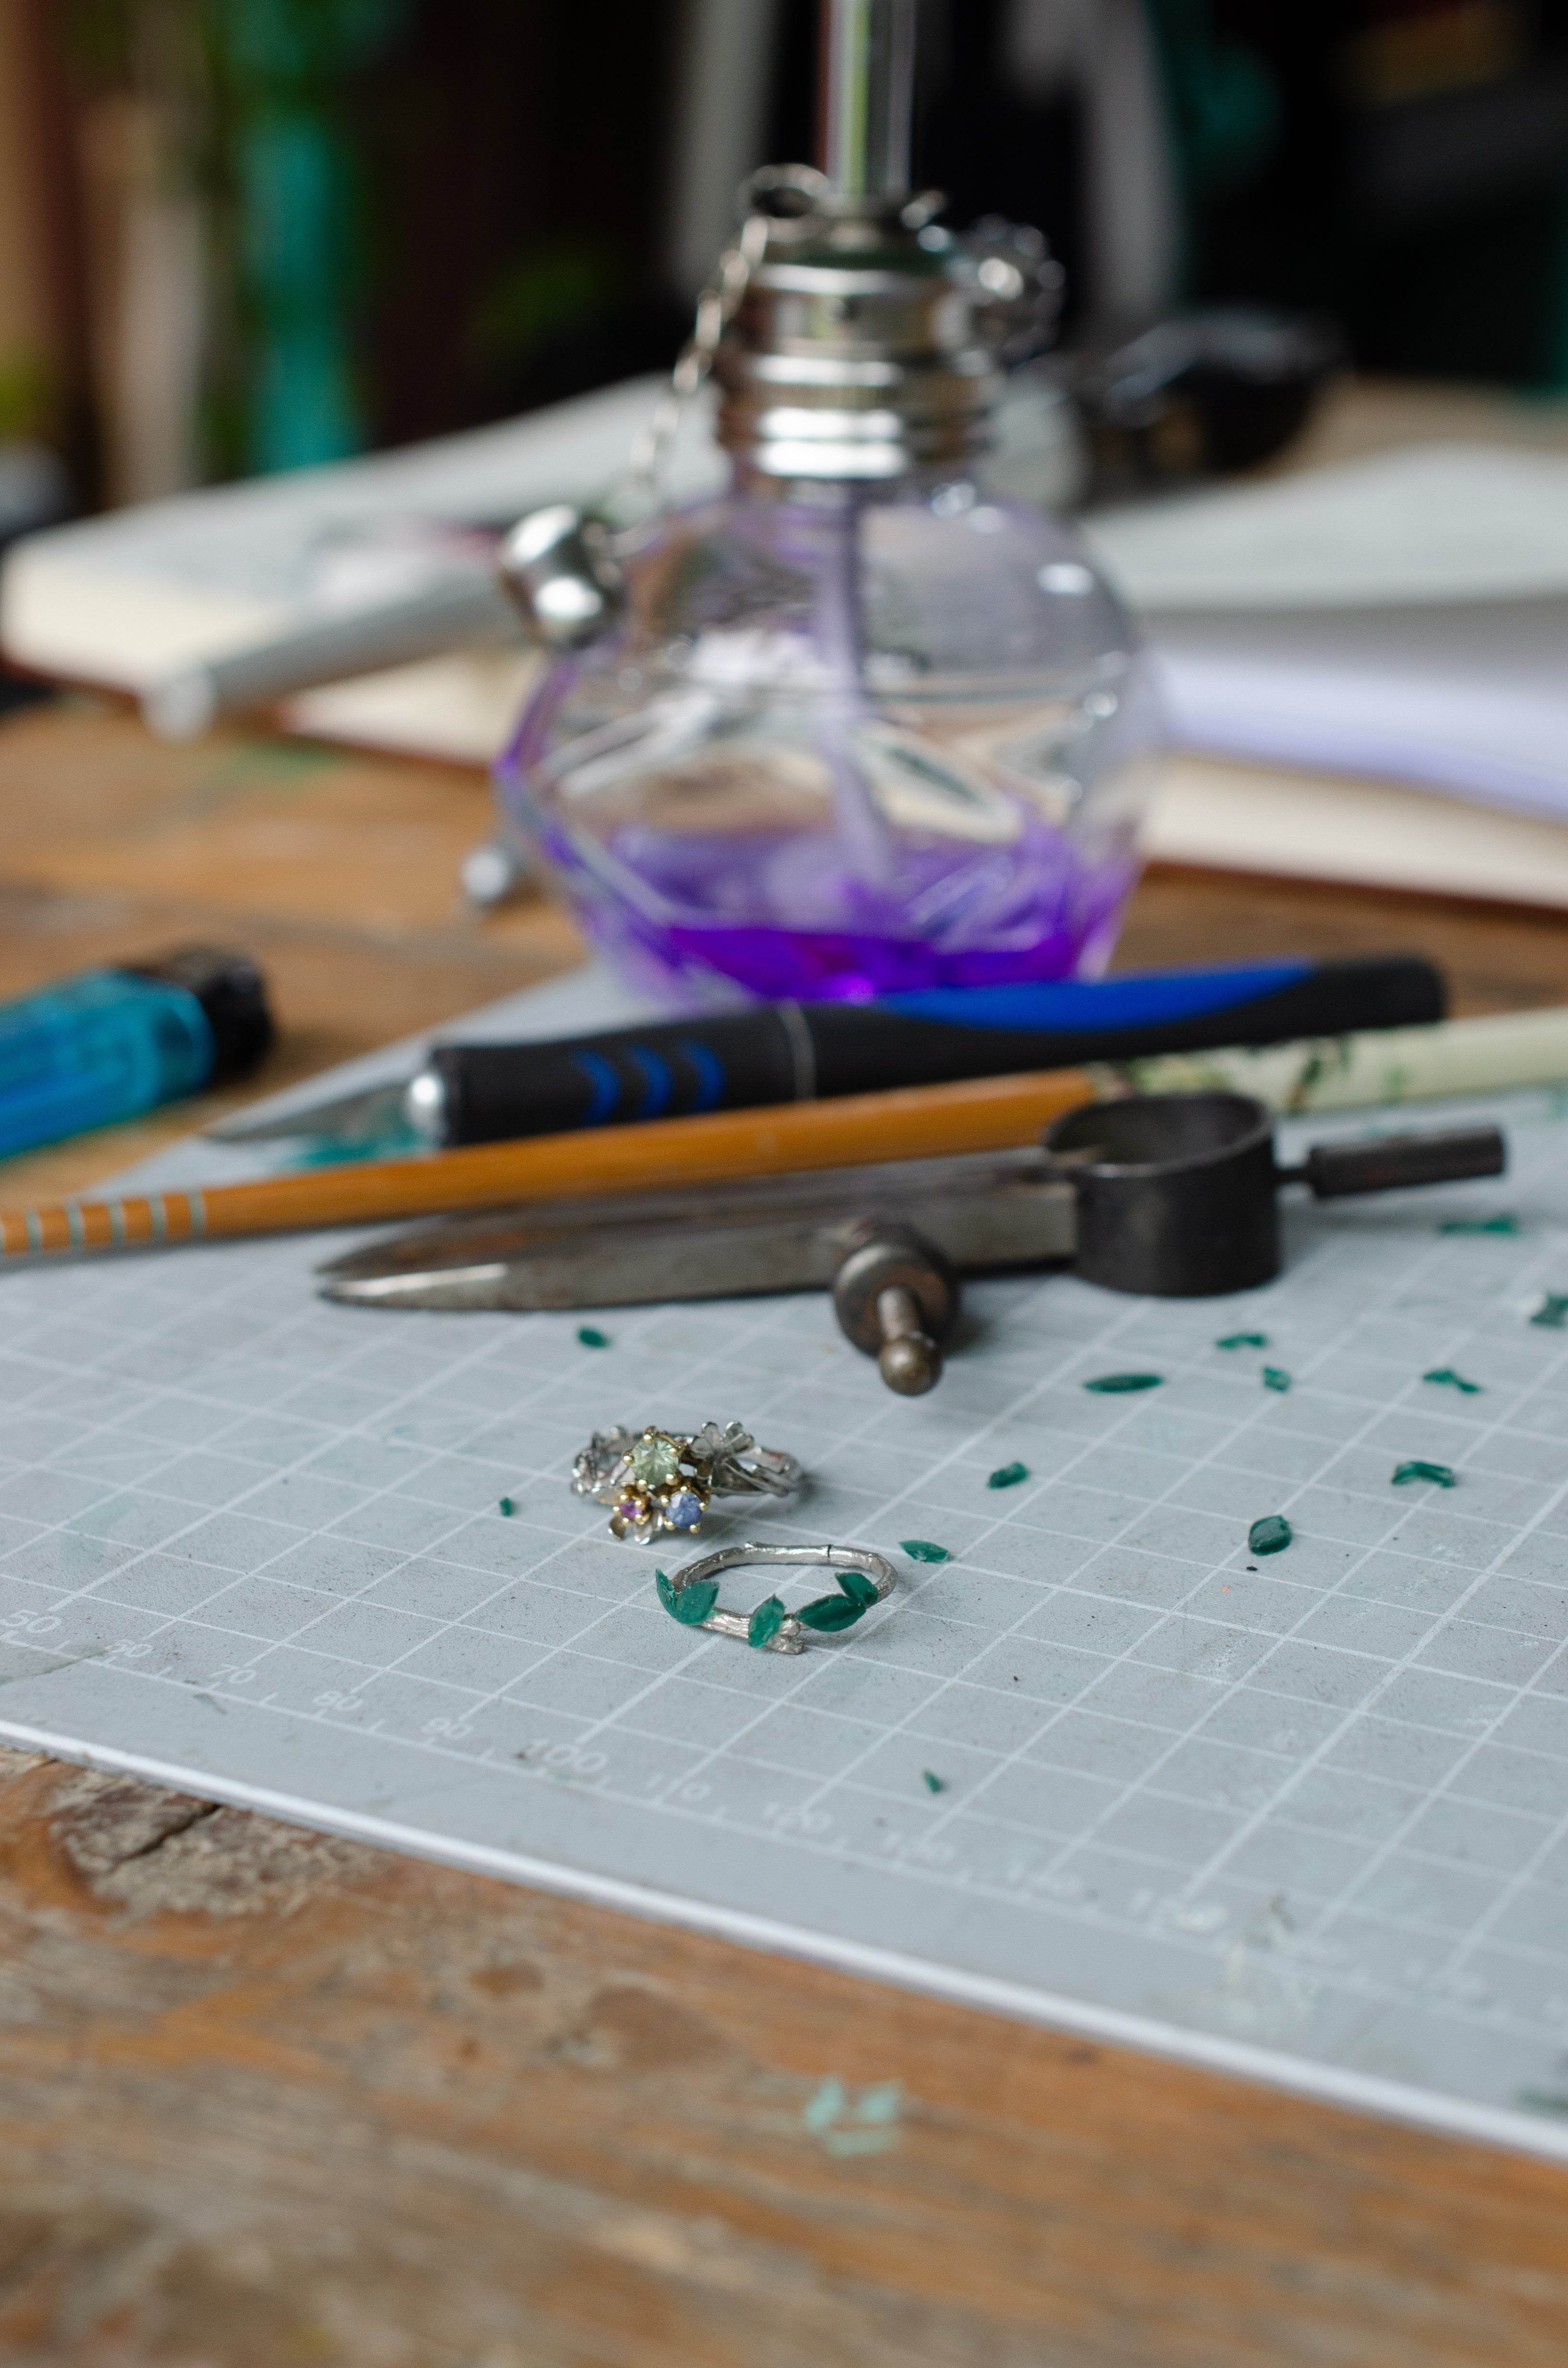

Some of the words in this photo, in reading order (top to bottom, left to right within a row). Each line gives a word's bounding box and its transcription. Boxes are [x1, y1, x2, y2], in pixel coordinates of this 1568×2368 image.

[0, 1609, 62, 1633] 50
[208, 1663, 257, 1684] 70
[312, 1690, 364, 1712] 80
[526, 1738, 609, 1773] 100
